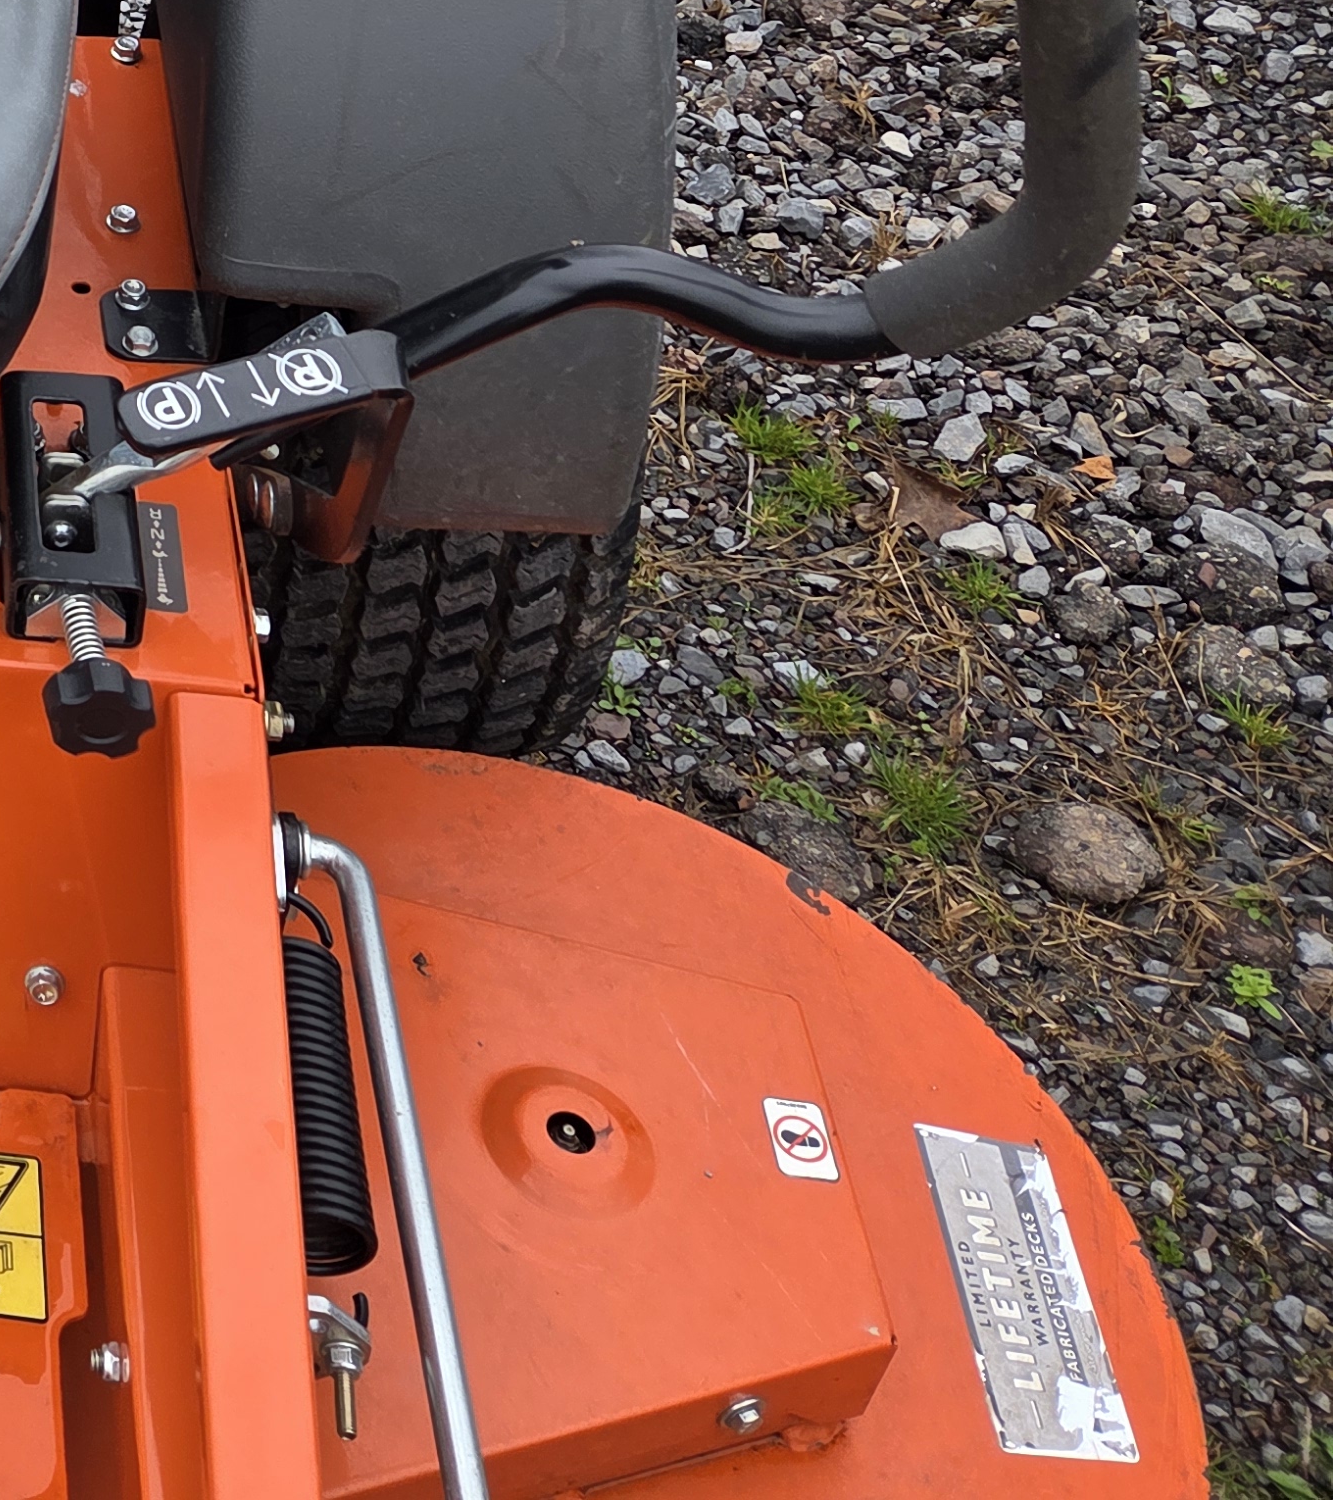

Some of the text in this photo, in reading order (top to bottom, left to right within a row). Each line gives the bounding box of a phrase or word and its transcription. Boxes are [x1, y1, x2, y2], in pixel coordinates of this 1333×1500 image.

[957, 1240, 991, 1327] LIMITED
[960, 1189, 1044, 1390] LIFETIME
[1006, 1237, 1049, 1345] WARRANTY
[1020, 1212, 1083, 1381] FABRICATED DECKS
